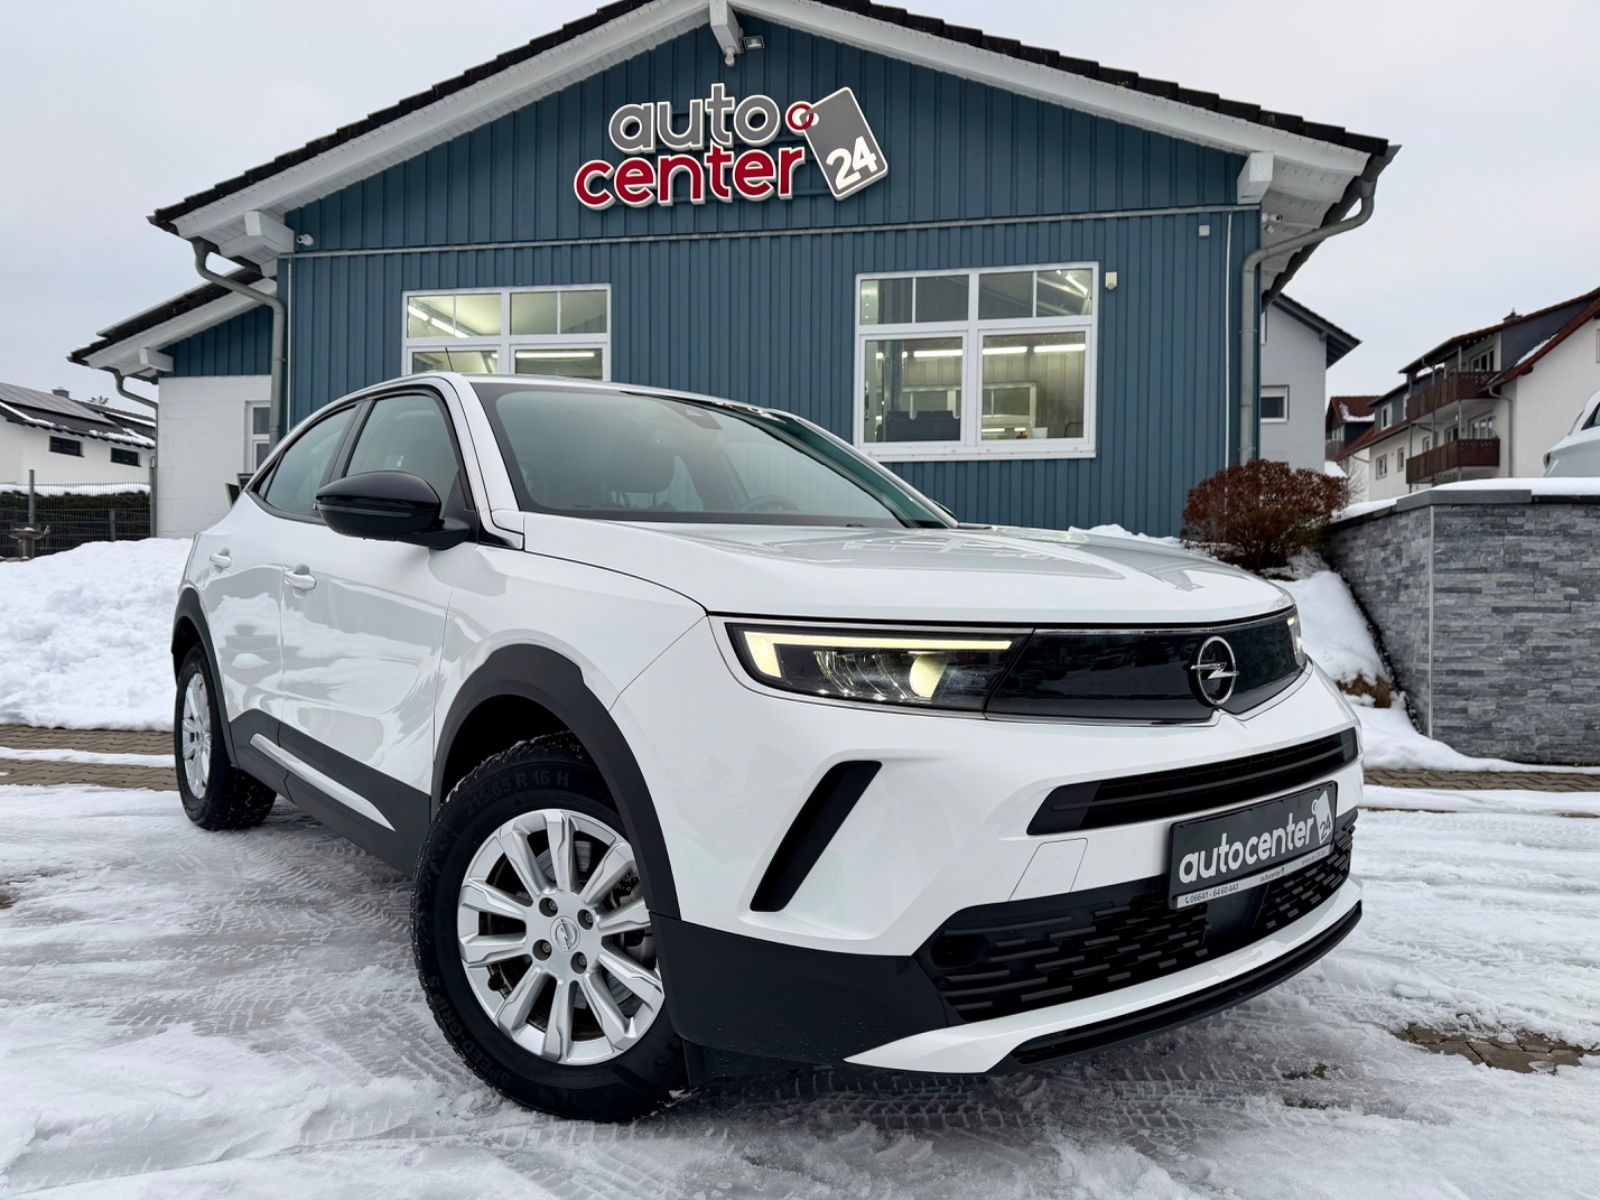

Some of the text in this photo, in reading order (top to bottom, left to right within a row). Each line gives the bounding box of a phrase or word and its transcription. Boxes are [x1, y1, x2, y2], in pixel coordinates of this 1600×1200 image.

[608, 83, 781, 154] auto
[574, 141, 805, 210] center
[825, 135, 879, 190] 24
[515, 772, 528, 789] R
[532, 769, 550, 786] 16
[556, 771, 570, 787] H
[1179, 812, 1315, 884] autocenter
[1320, 814, 1332, 843] 24
[433, 991, 512, 1088] SPEED-GRIP
